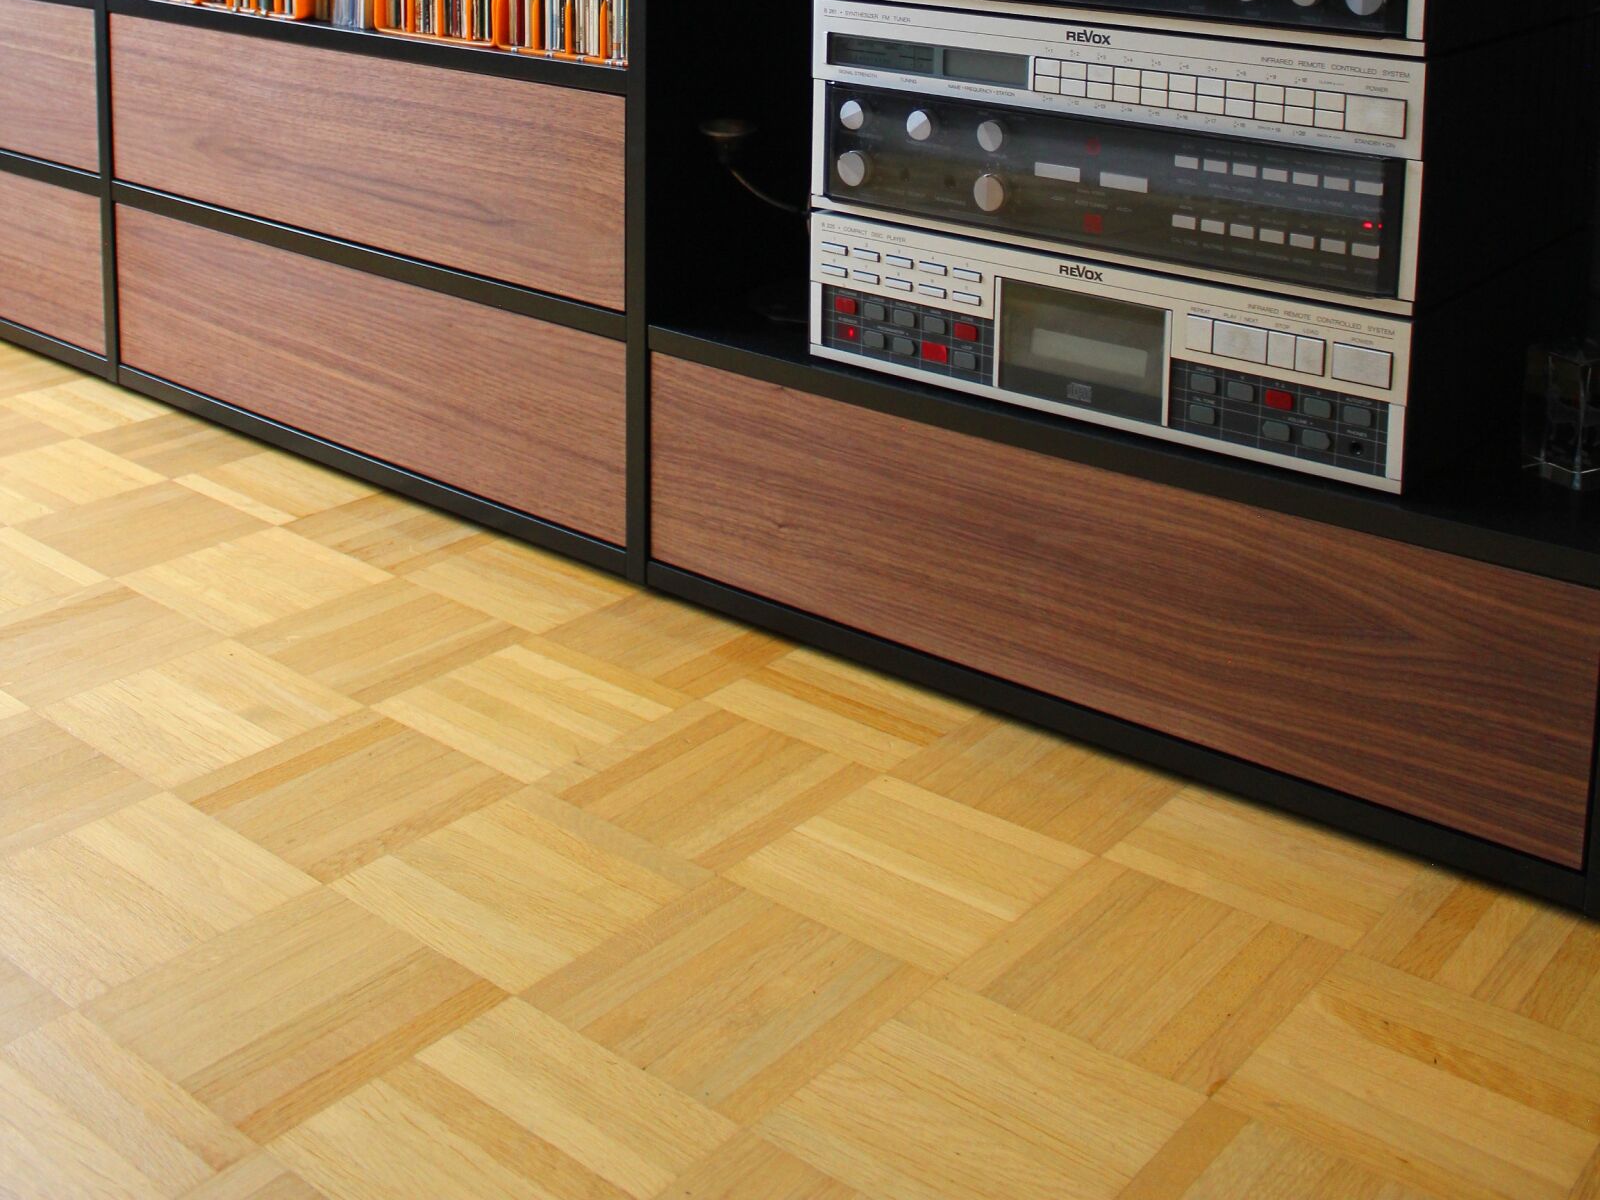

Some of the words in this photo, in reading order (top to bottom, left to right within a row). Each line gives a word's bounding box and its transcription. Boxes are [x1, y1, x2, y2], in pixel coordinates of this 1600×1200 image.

[845, 10, 878, 20] SYNTHESIZER
[1260, 56, 1293, 66] INFRARED
[1298, 60, 1326, 69] REMOTE
[1331, 63, 1378, 75] CONTROLLED
[1382, 70, 1410, 79] SYSTEM
[1365, 85, 1389, 93] POWER
[843, 226, 868, 236] COMPACT
[886, 234, 906, 243] PLAYER
[1247, 303, 1279, 314] INFRARED
[1284, 310, 1312, 320] REMOTE
[1316, 316, 1361, 330] CONTROLLED
[1367, 325, 1395, 336] SYSTEM
[1351, 336, 1374, 346] POWER
